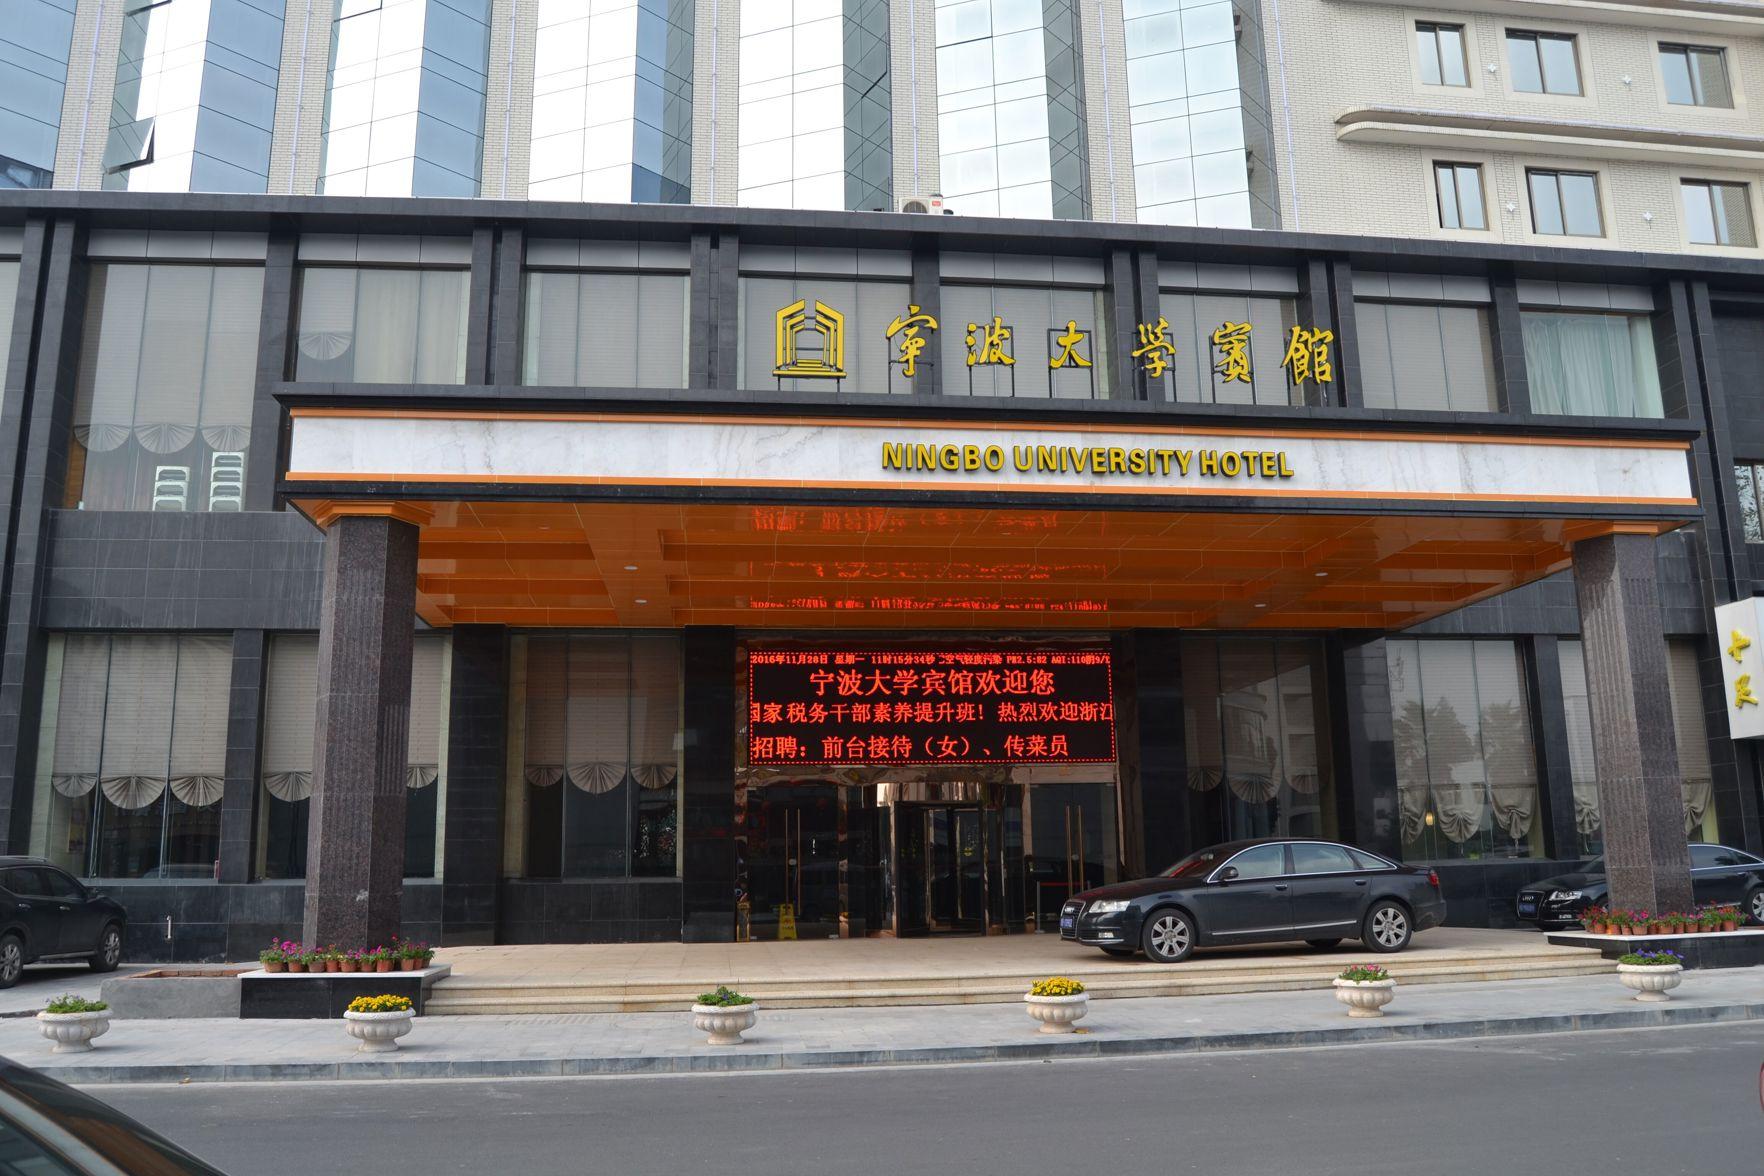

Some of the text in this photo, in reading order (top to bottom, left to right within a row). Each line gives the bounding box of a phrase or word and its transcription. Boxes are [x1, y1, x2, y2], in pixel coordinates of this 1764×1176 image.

[882, 442, 1294, 477] NINGBO UNIVERSITY HOTEL
[834, 655, 865, 664] 星期一
[810, 668, 1055, 696] 宁波大学宾馆欢迎您
